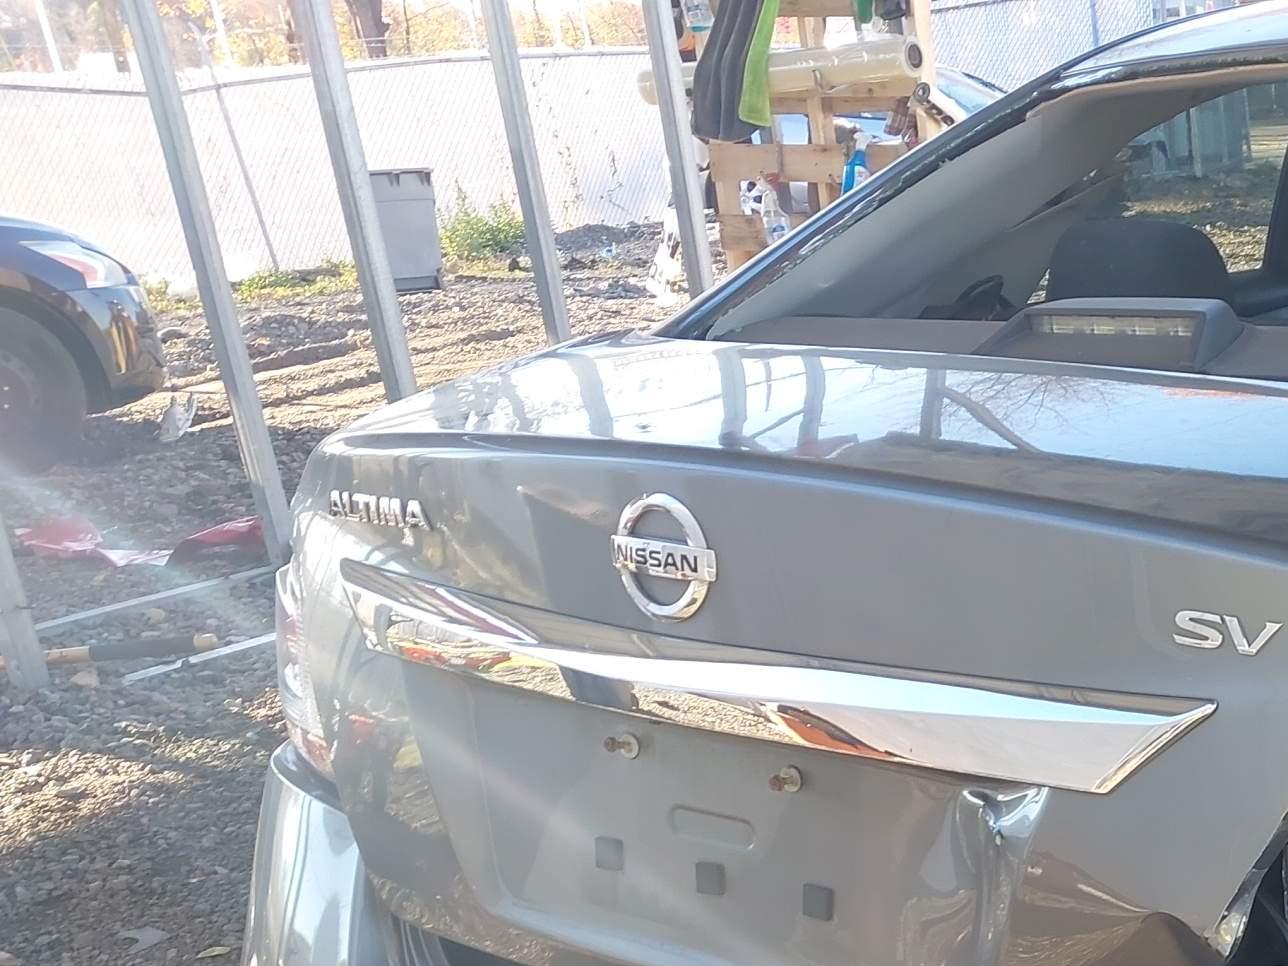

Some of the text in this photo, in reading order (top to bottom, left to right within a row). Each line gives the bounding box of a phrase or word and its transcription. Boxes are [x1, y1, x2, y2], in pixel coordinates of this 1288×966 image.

[329, 489, 432, 532] ALTIMA
[616, 543, 699, 574] NISSAN
[1172, 609, 1284, 656] SV
